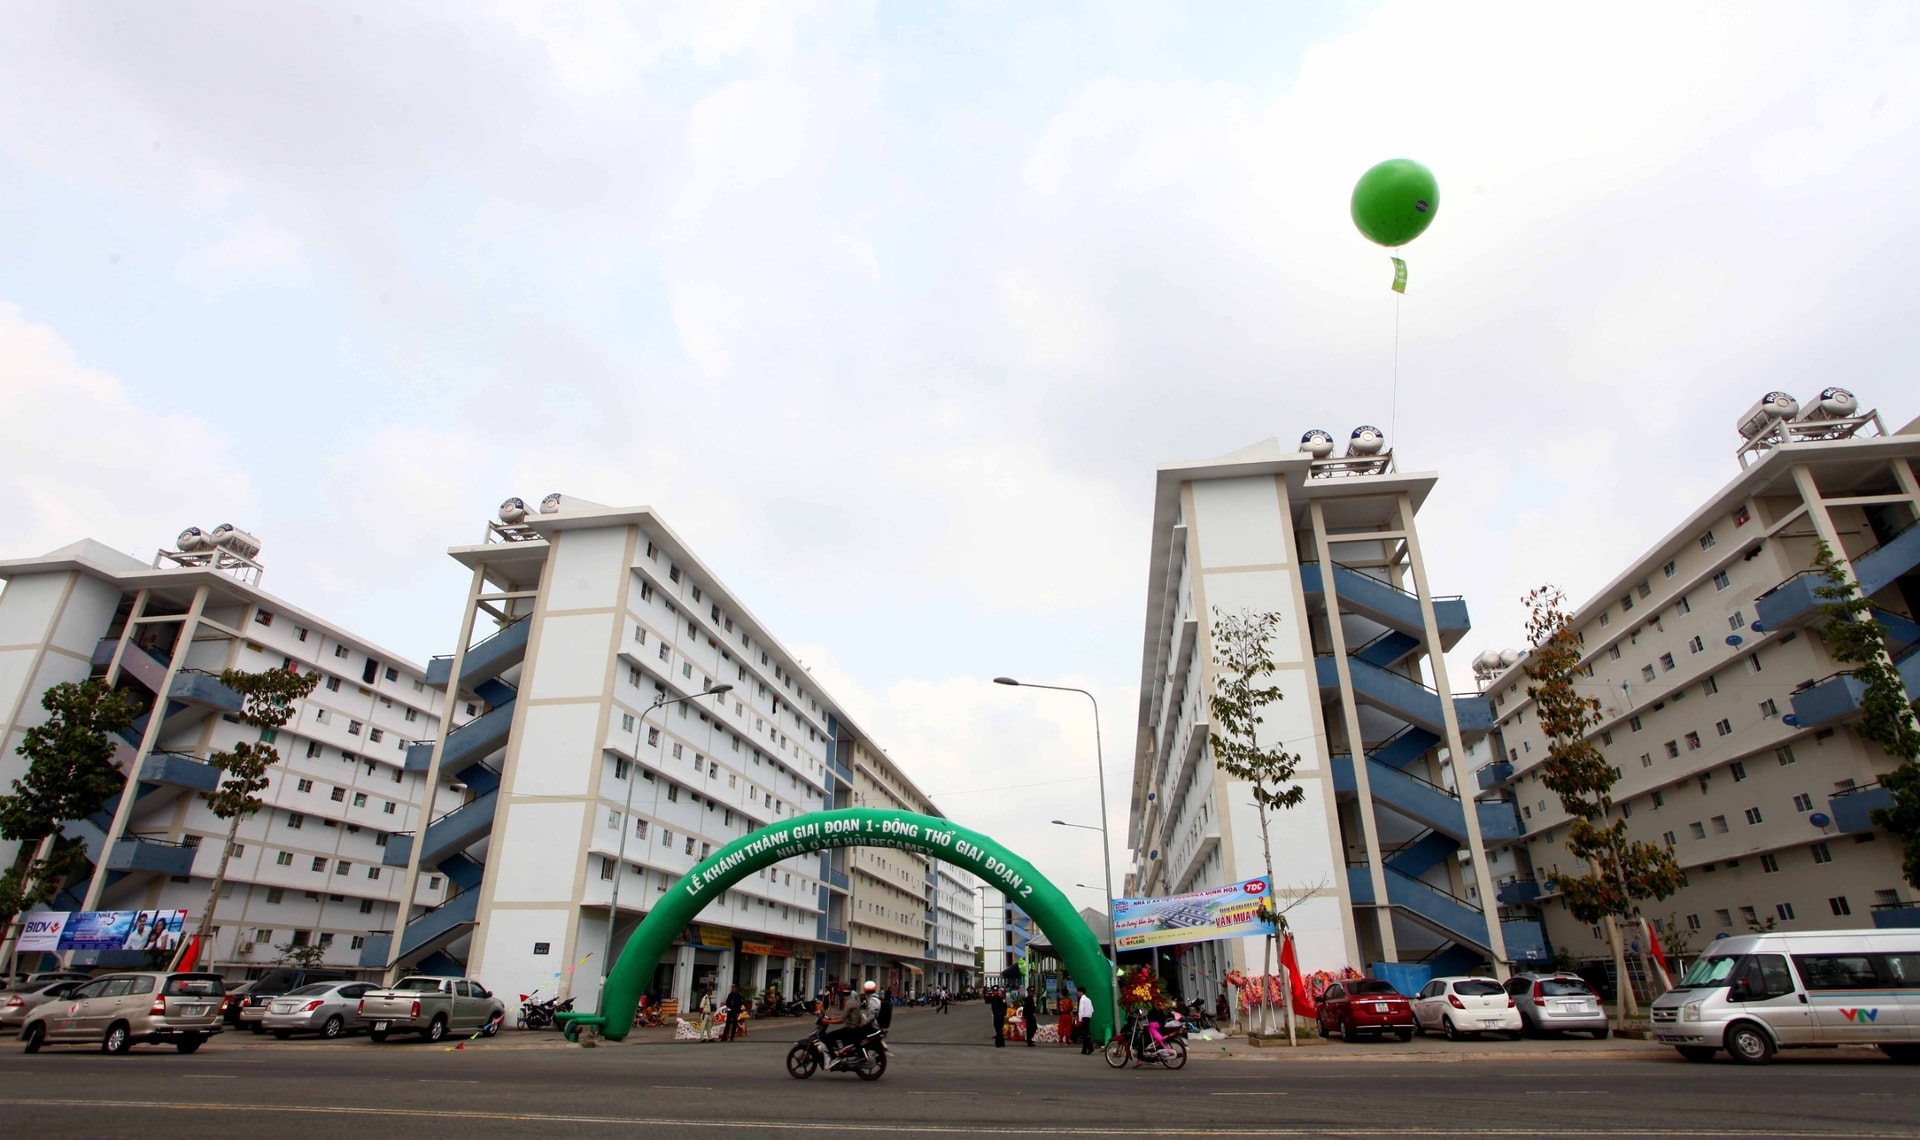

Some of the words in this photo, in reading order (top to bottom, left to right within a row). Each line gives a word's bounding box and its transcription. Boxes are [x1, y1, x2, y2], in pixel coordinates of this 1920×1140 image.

[776, 840, 806, 859] NHÀ
[822, 834, 841, 847] XÃ
[869, 837, 934, 857] BECAMEX
[686, 874, 705, 896] LỄ
[703, 851, 746, 884] KHÁNH
[744, 830, 789, 858] THÀNH
[793, 823, 820, 840] GIAI
[824, 818, 860, 835] ĐOẠN
[924, 827, 956, 847] THỔ
[955, 839, 985, 862] GIAI
[984, 856, 1023, 890] ĐOẠN
[1020, 885, 1033, 898] 2
[1246, 882, 1263, 892] TDC
[1233, 911, 1250, 923] MUA
[25, 921, 52, 932] BIDV
[1838, 1007, 1878, 1023] VTV
